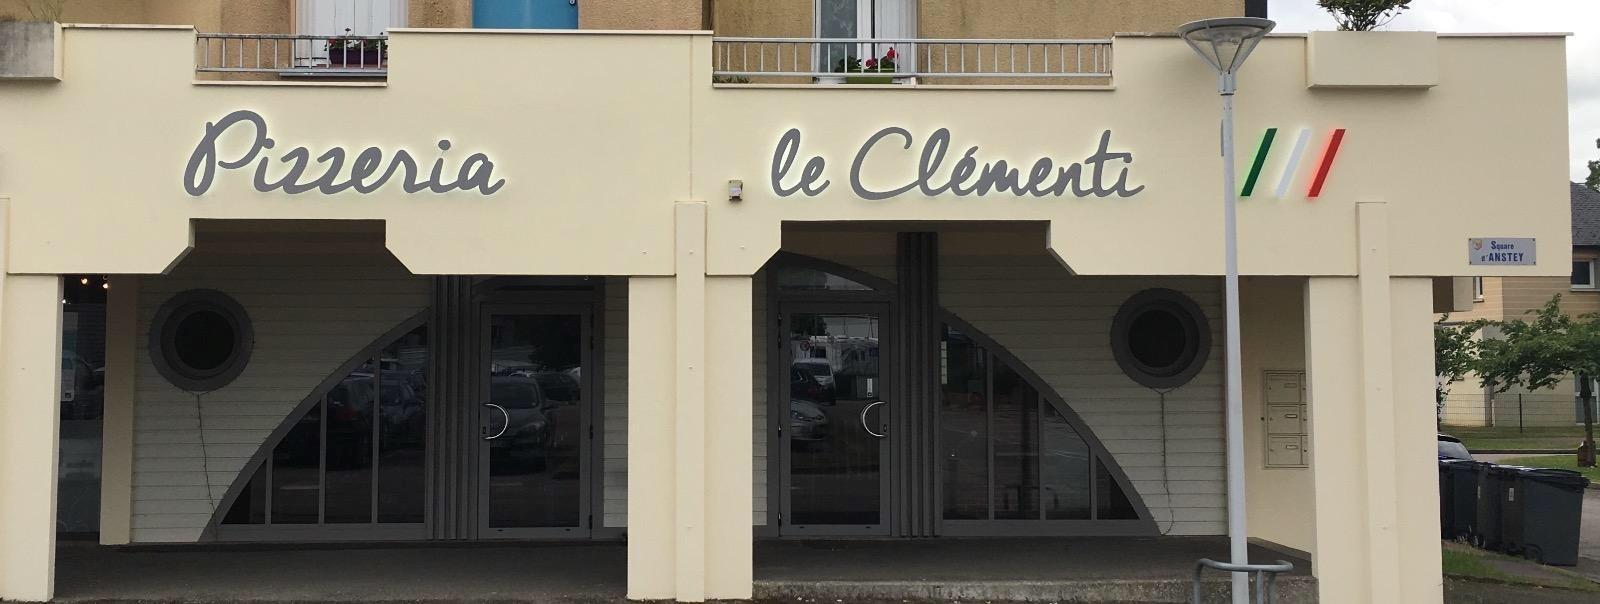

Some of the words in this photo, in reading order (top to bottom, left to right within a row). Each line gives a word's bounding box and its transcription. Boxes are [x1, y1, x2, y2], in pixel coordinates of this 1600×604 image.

[183, 110, 505, 196] Pizzeria
[771, 128, 830, 197] le
[849, 126, 1145, 200] Clémenti
[1481, 252, 1524, 262] d'ANSTEY
[1490, 240, 1515, 251] Square
